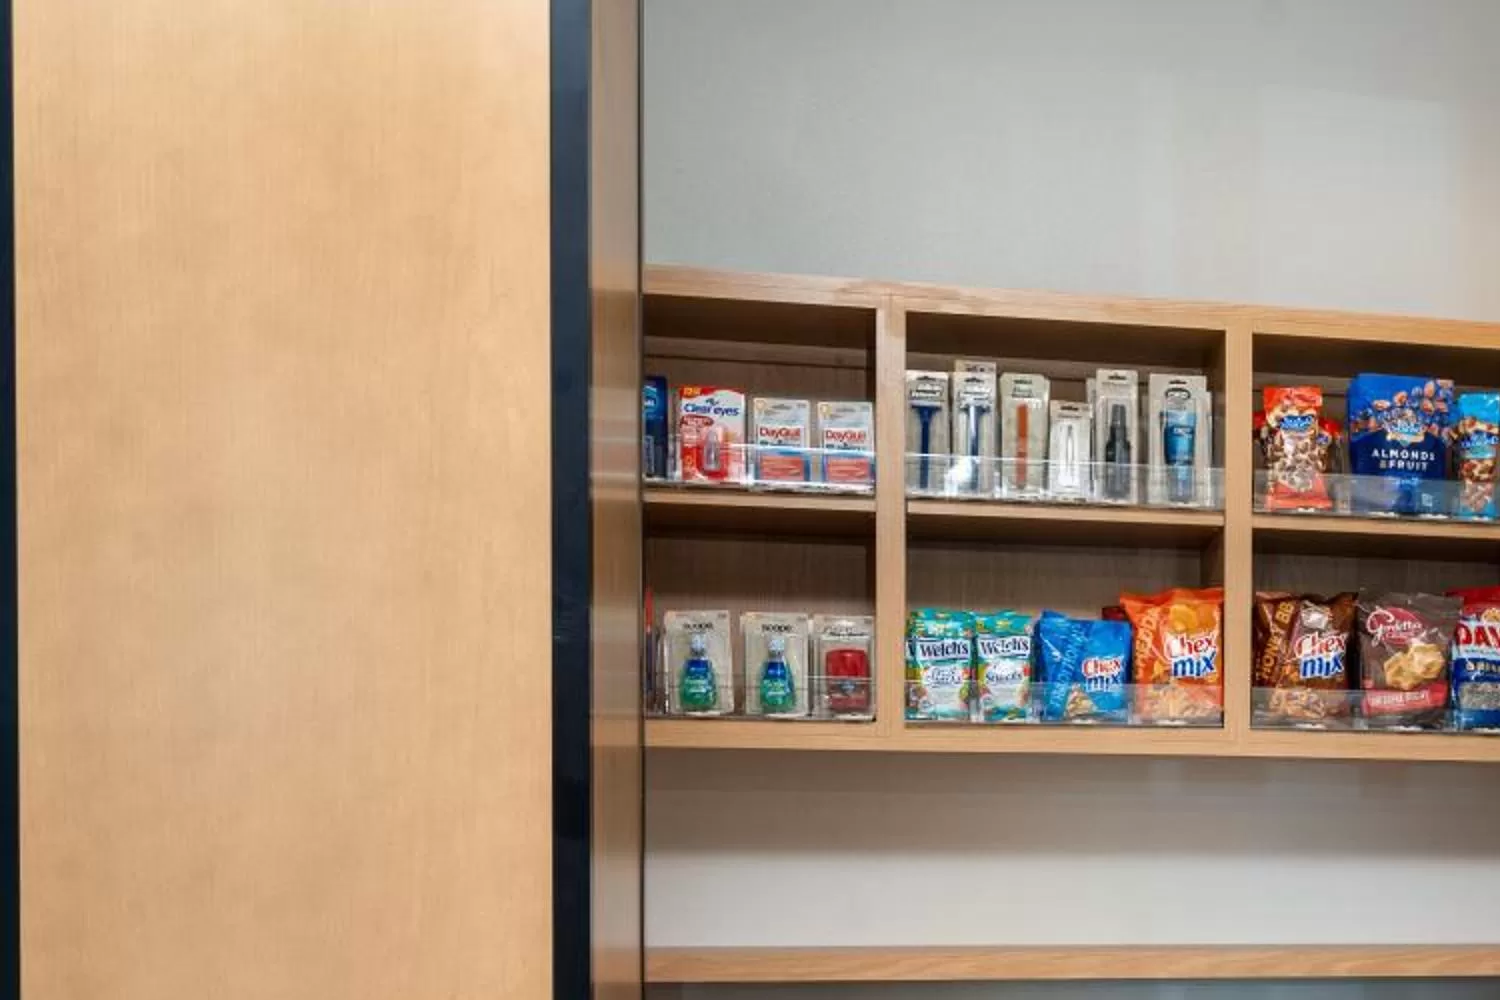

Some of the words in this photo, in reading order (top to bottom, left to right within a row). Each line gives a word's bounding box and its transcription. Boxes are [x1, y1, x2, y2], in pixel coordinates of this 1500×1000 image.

[683, 402, 712, 415] Clear
[714, 406, 739, 417] eyes
[1371, 447, 1436, 462] ALMONDS
[1389, 458, 1429, 472] FRUIT
[920, 639, 970, 658] Welch's
[979, 636, 1030, 657] Welch's
[1166, 632, 1216, 656] Chex
[1294, 633, 1347, 658] Chex
[1084, 658, 1121, 676] Chex
[1172, 652, 1216, 679] mix
[1300, 653, 1344, 680] mix
